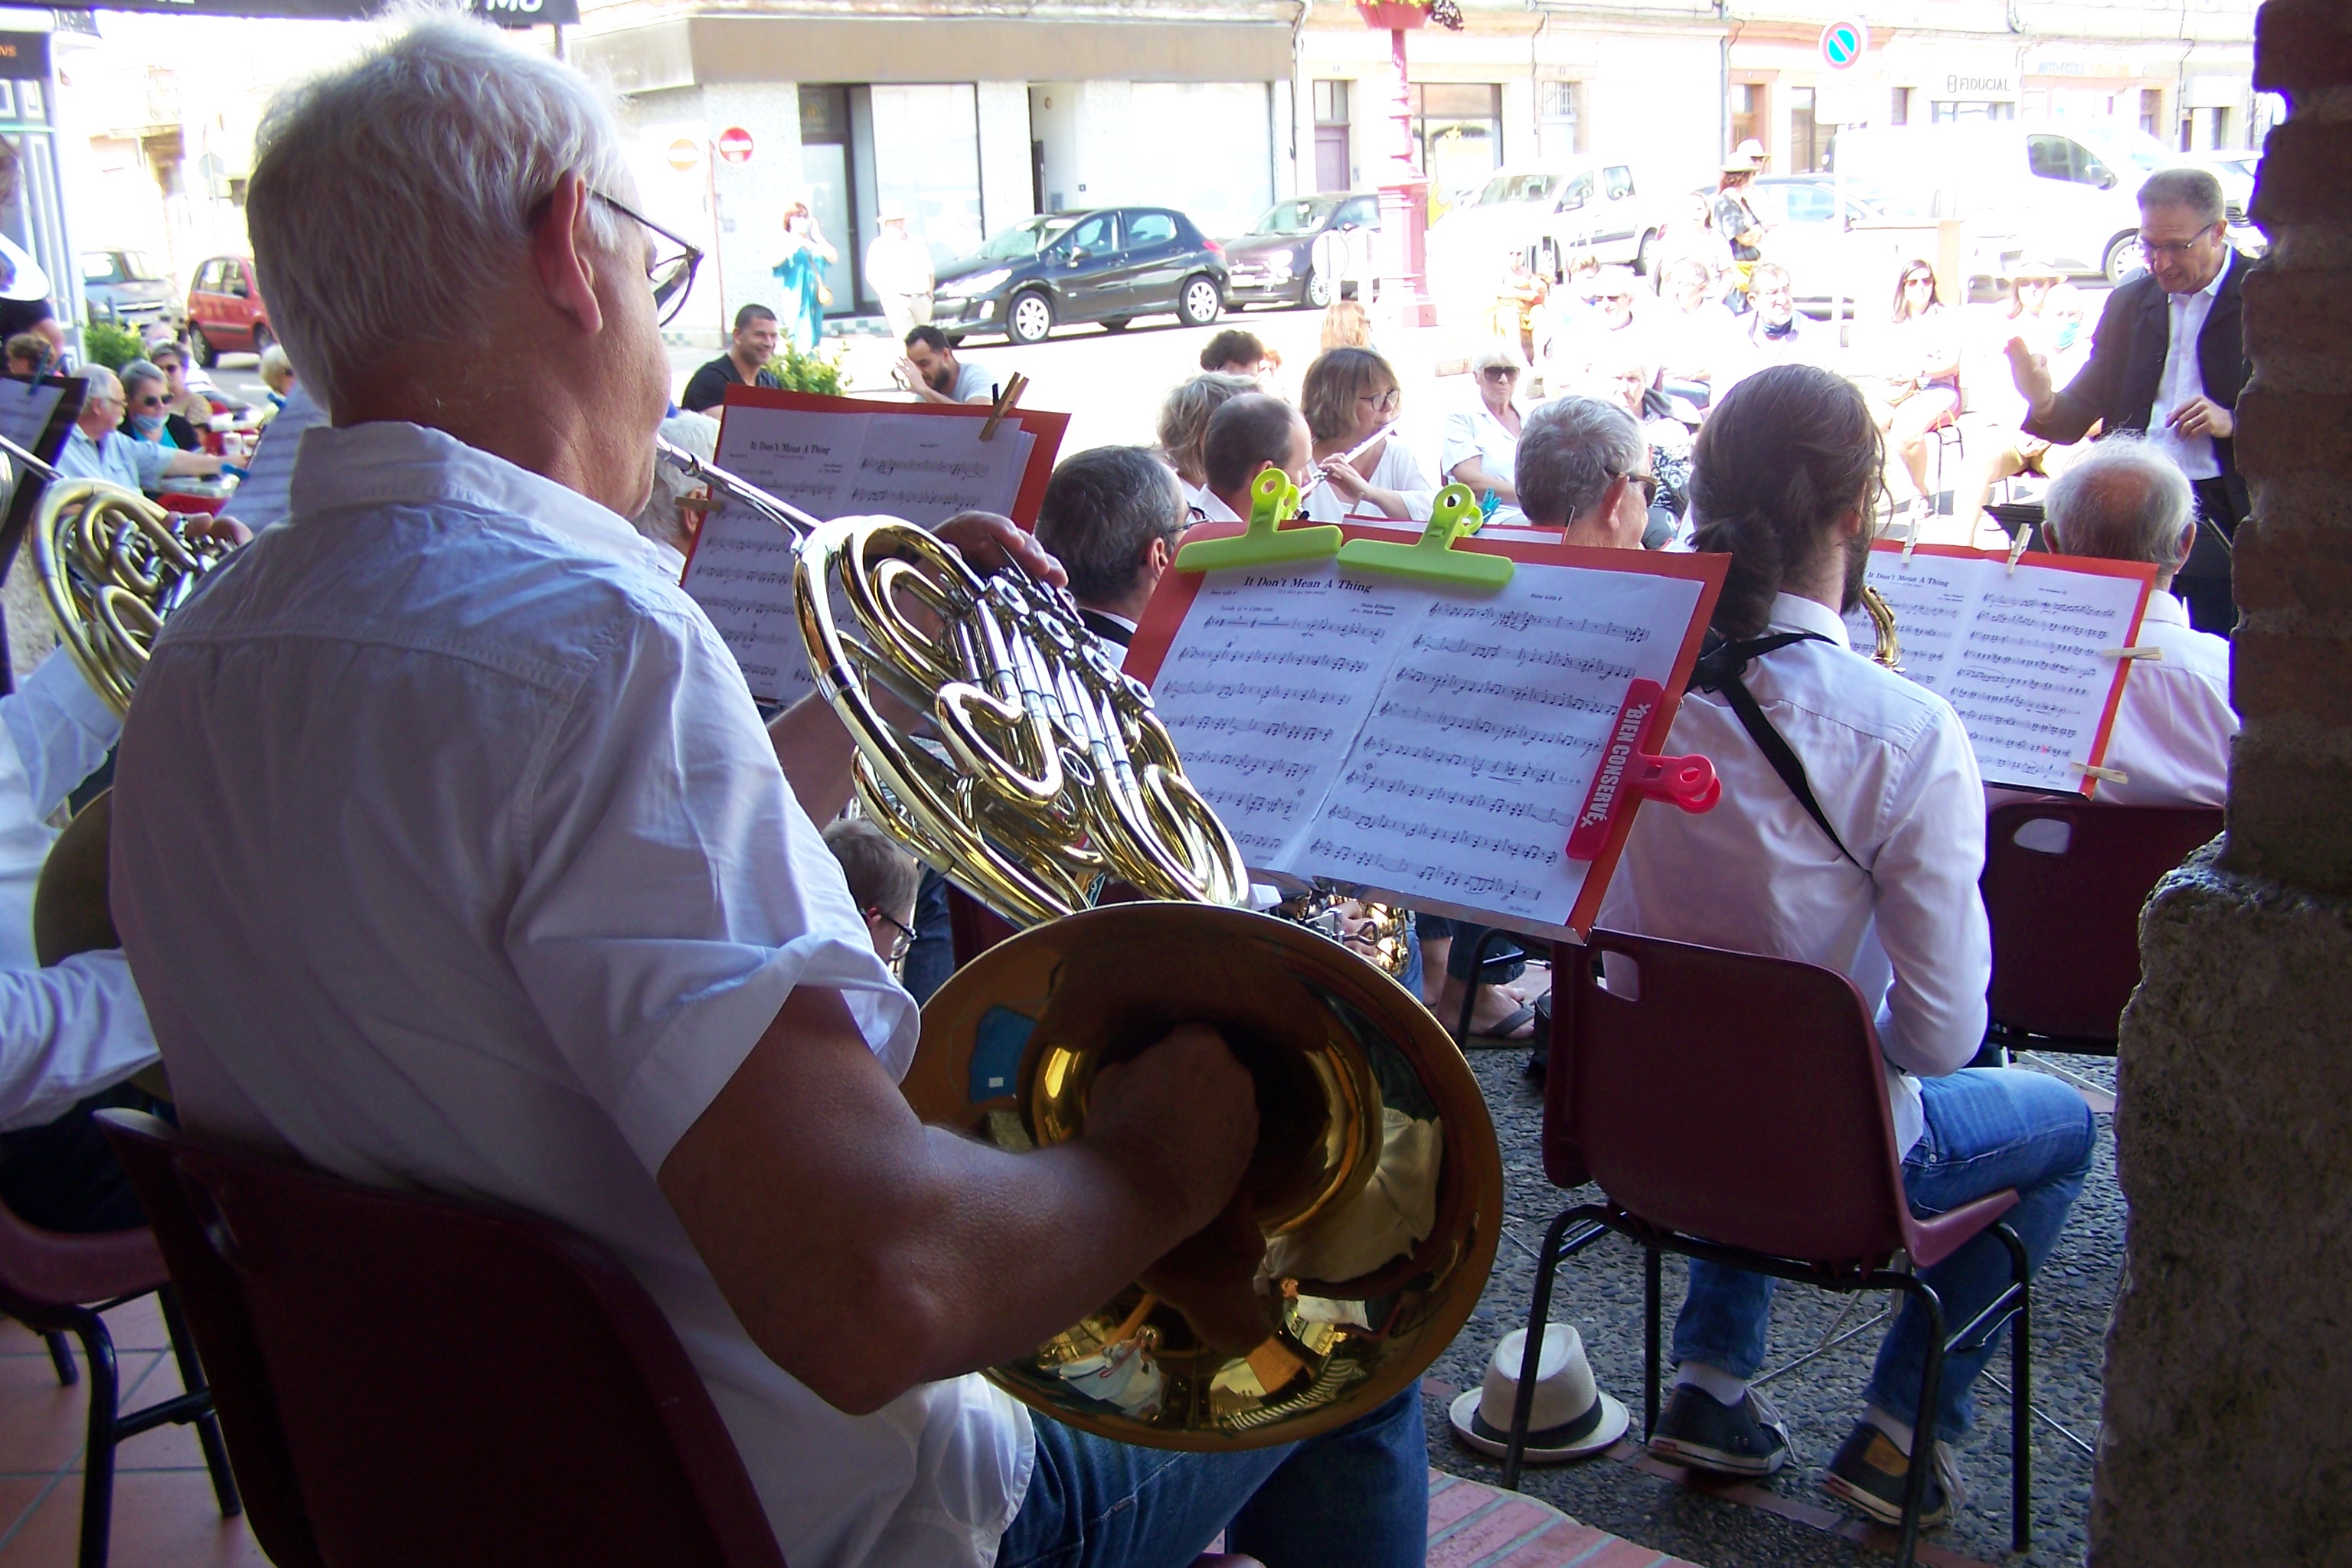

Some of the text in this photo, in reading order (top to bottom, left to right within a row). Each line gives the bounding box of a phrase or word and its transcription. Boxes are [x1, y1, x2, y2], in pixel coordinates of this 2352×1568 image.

[1960, 77, 2011, 92] FIDUCIAL
[1243, 576, 1253, 586] It
[1256, 577, 1288, 587] Don't
[1291, 578, 1321, 589] Mean
[1323, 579, 1333, 588] A
[1338, 580, 1374, 593] Thing
[1928, 577, 1950, 587] Thing
[1586, 707, 1644, 821] BIEN CONSERVÉ
